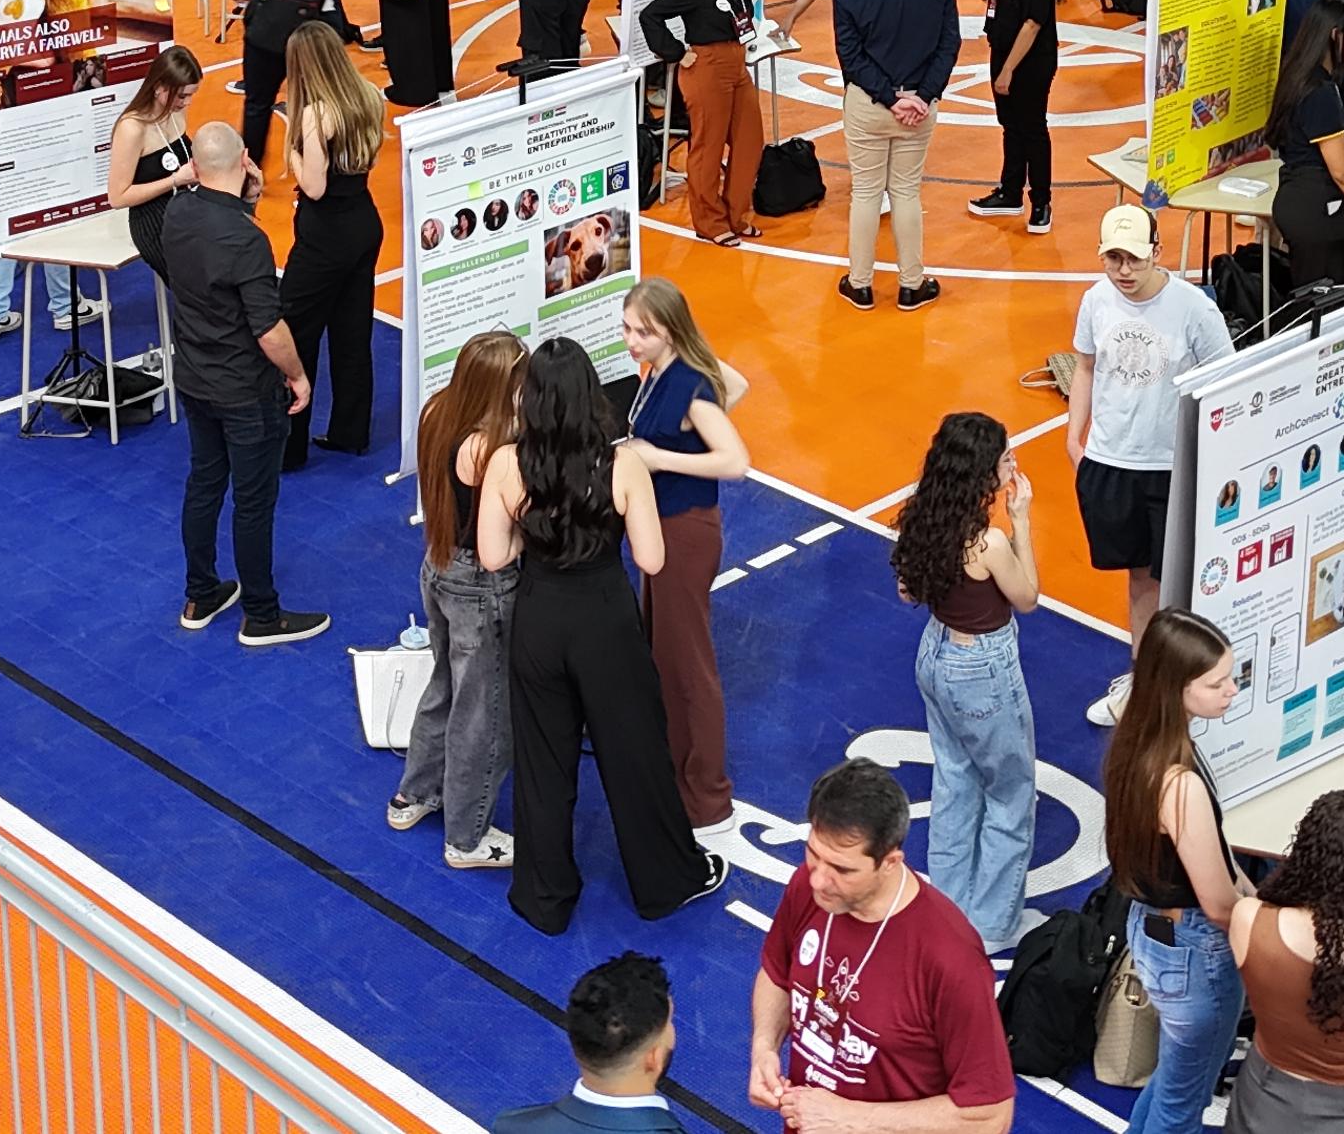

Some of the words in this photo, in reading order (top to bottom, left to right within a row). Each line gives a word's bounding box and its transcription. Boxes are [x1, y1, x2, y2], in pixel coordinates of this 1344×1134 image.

[35, 18, 70, 39] ALSO
[27, 40, 38, 55] A
[526, 123, 578, 146] CREATIVITY
[581, 117, 599, 129] AND
[527, 121, 616, 155] ENTREPRENEURSHIP
[489, 179, 502, 190] BE
[505, 169, 534, 184] THEIR
[537, 158, 567, 174] VOICE
[1113, 331, 1154, 346] VERSACE
[1275, 407, 1330, 439] ArchConnect
[1232, 591, 1263, 609] Solutions
